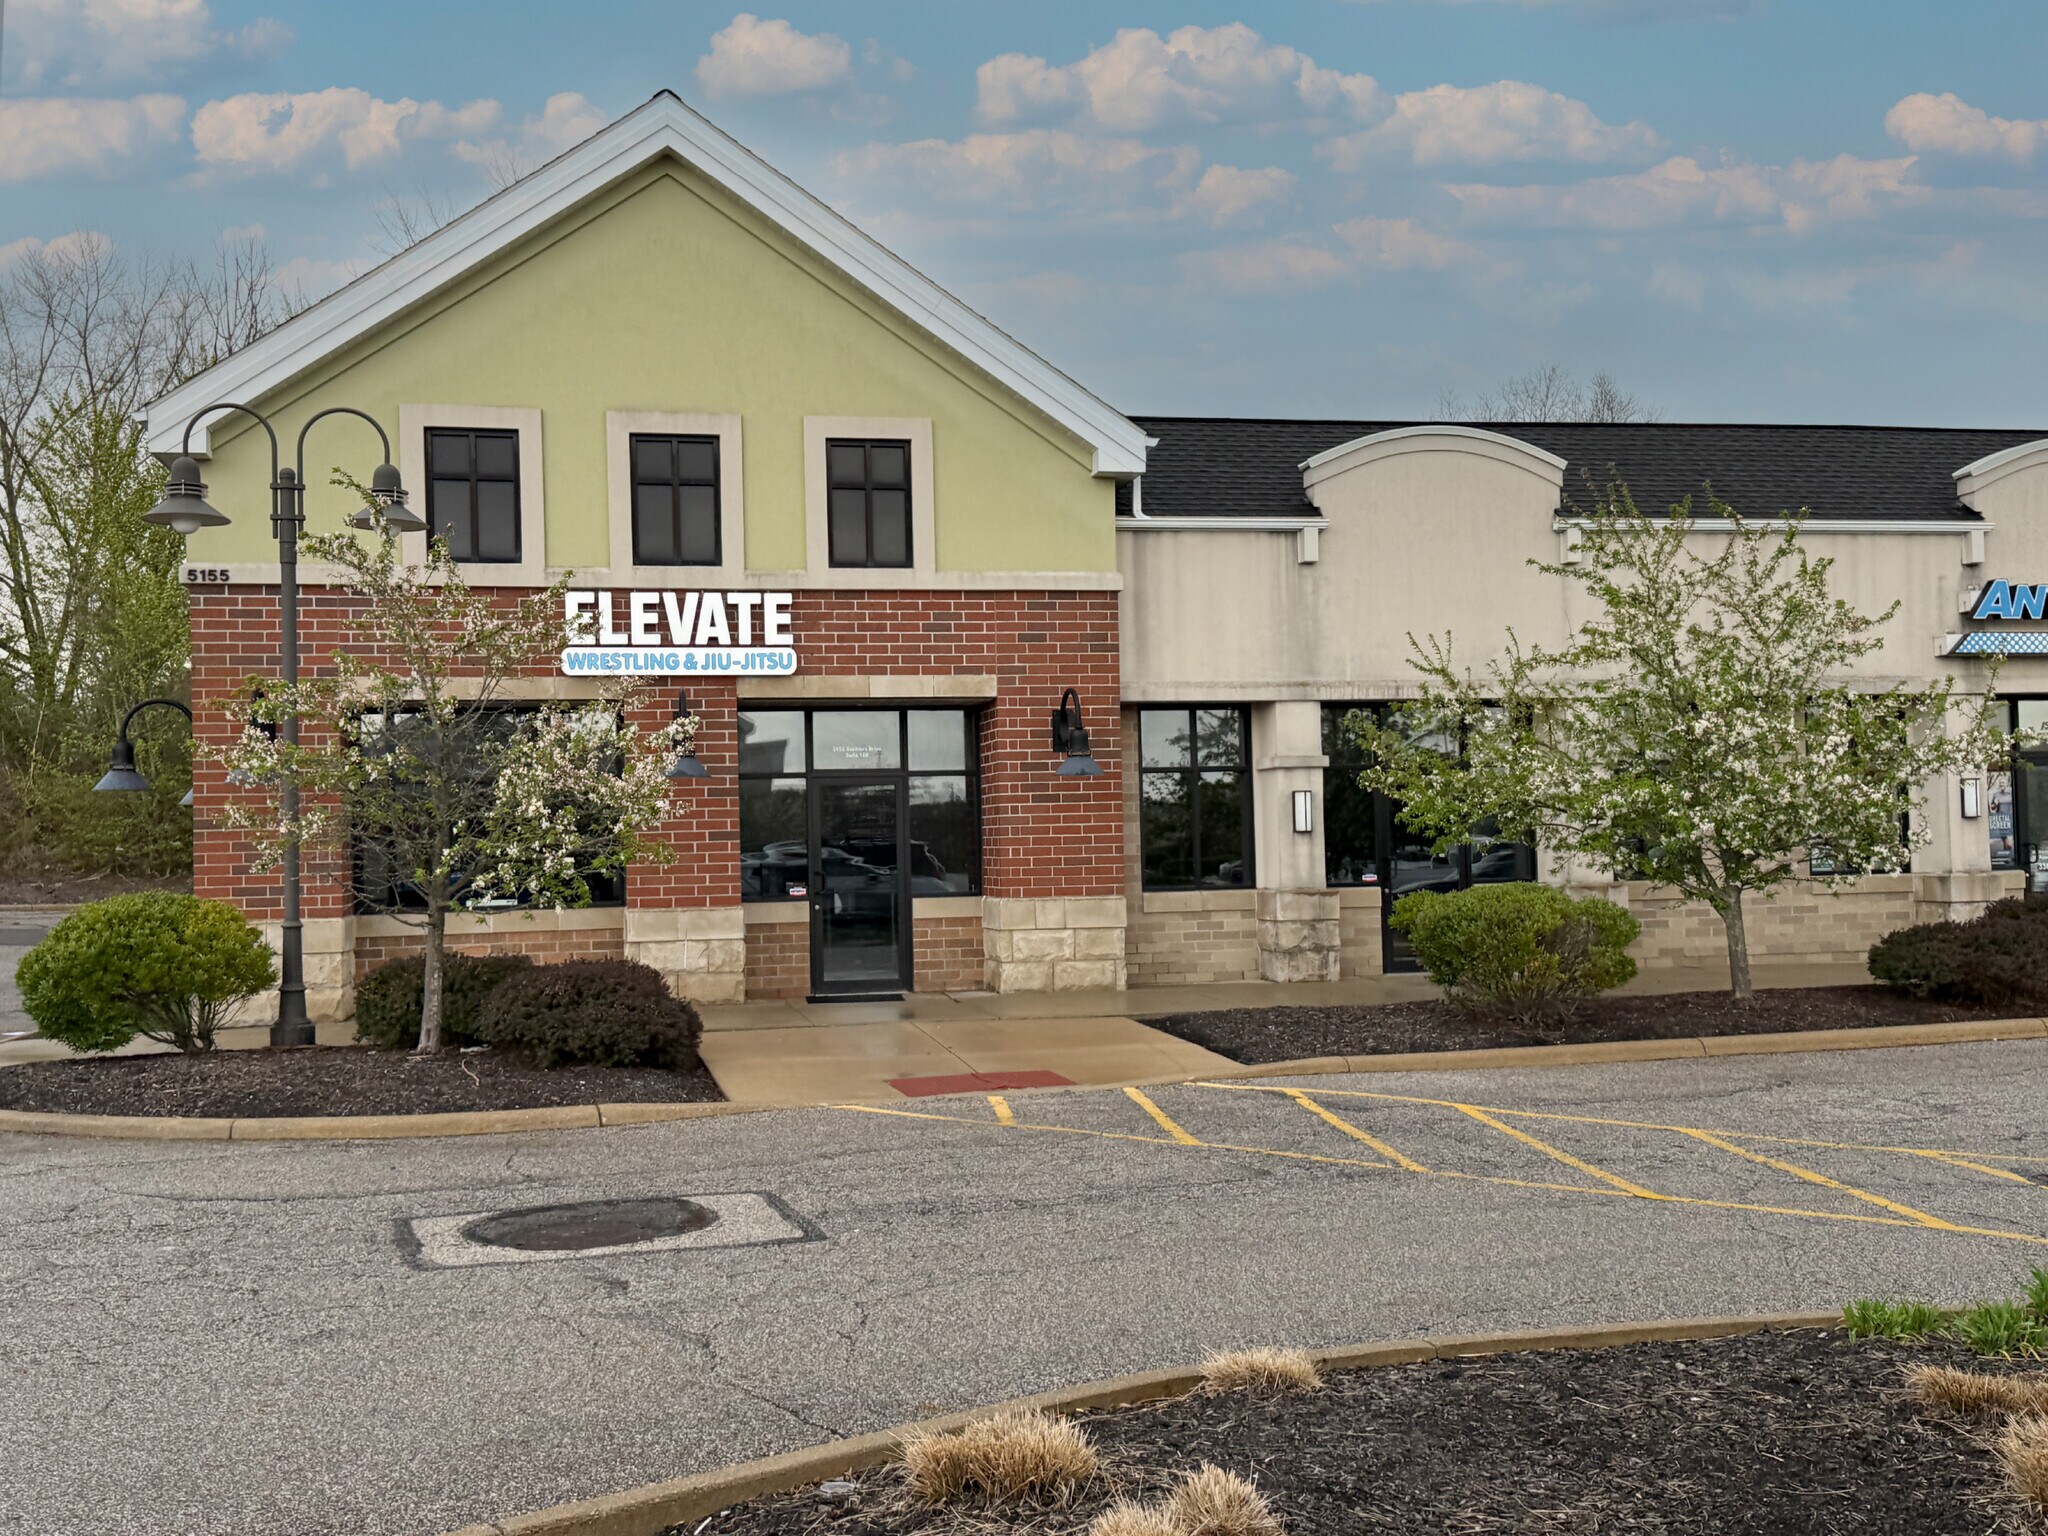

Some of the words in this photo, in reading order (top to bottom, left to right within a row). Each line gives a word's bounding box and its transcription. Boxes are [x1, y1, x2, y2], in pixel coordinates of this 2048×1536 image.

[187, 569, 230, 582] 5155
[1973, 578, 2048, 619] AN
[565, 591, 794, 646] ELEVATE
[566, 652, 680, 671] WRESTLING
[683, 652, 698, 671] &
[701, 652, 793, 671] JIU-JITSU
